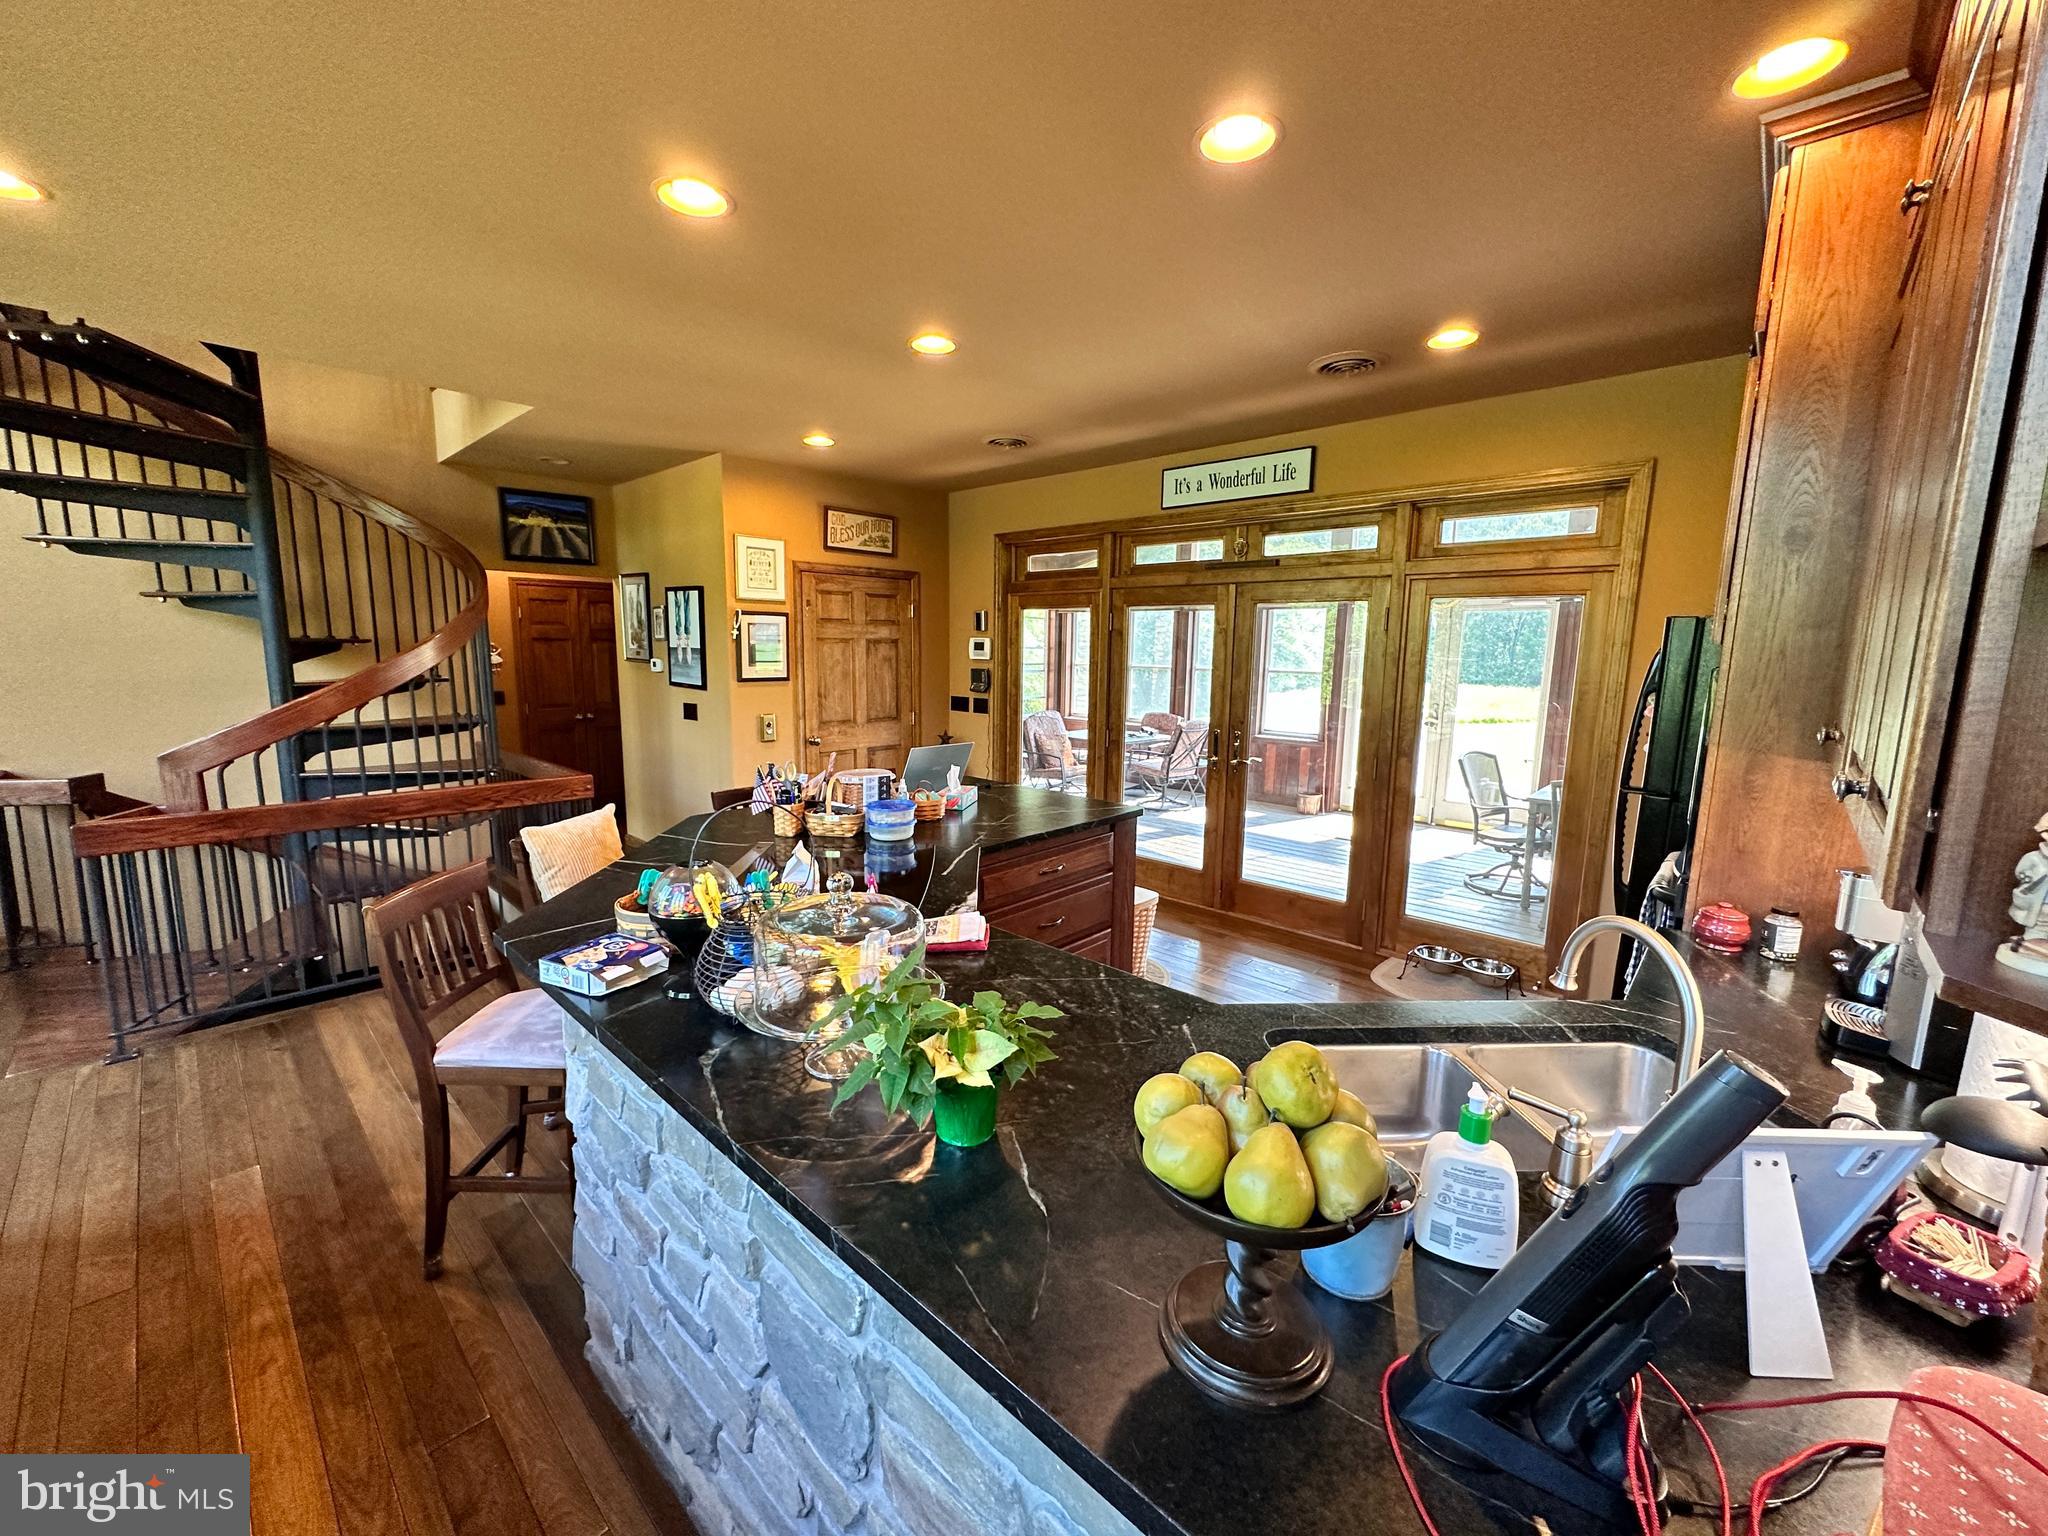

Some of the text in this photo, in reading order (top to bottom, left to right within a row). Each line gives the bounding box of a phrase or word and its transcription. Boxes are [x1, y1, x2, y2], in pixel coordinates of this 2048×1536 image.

[1174, 462, 1297, 495] It's a Wonderful Life
[830, 519, 891, 543] BLESS OUR HOME
